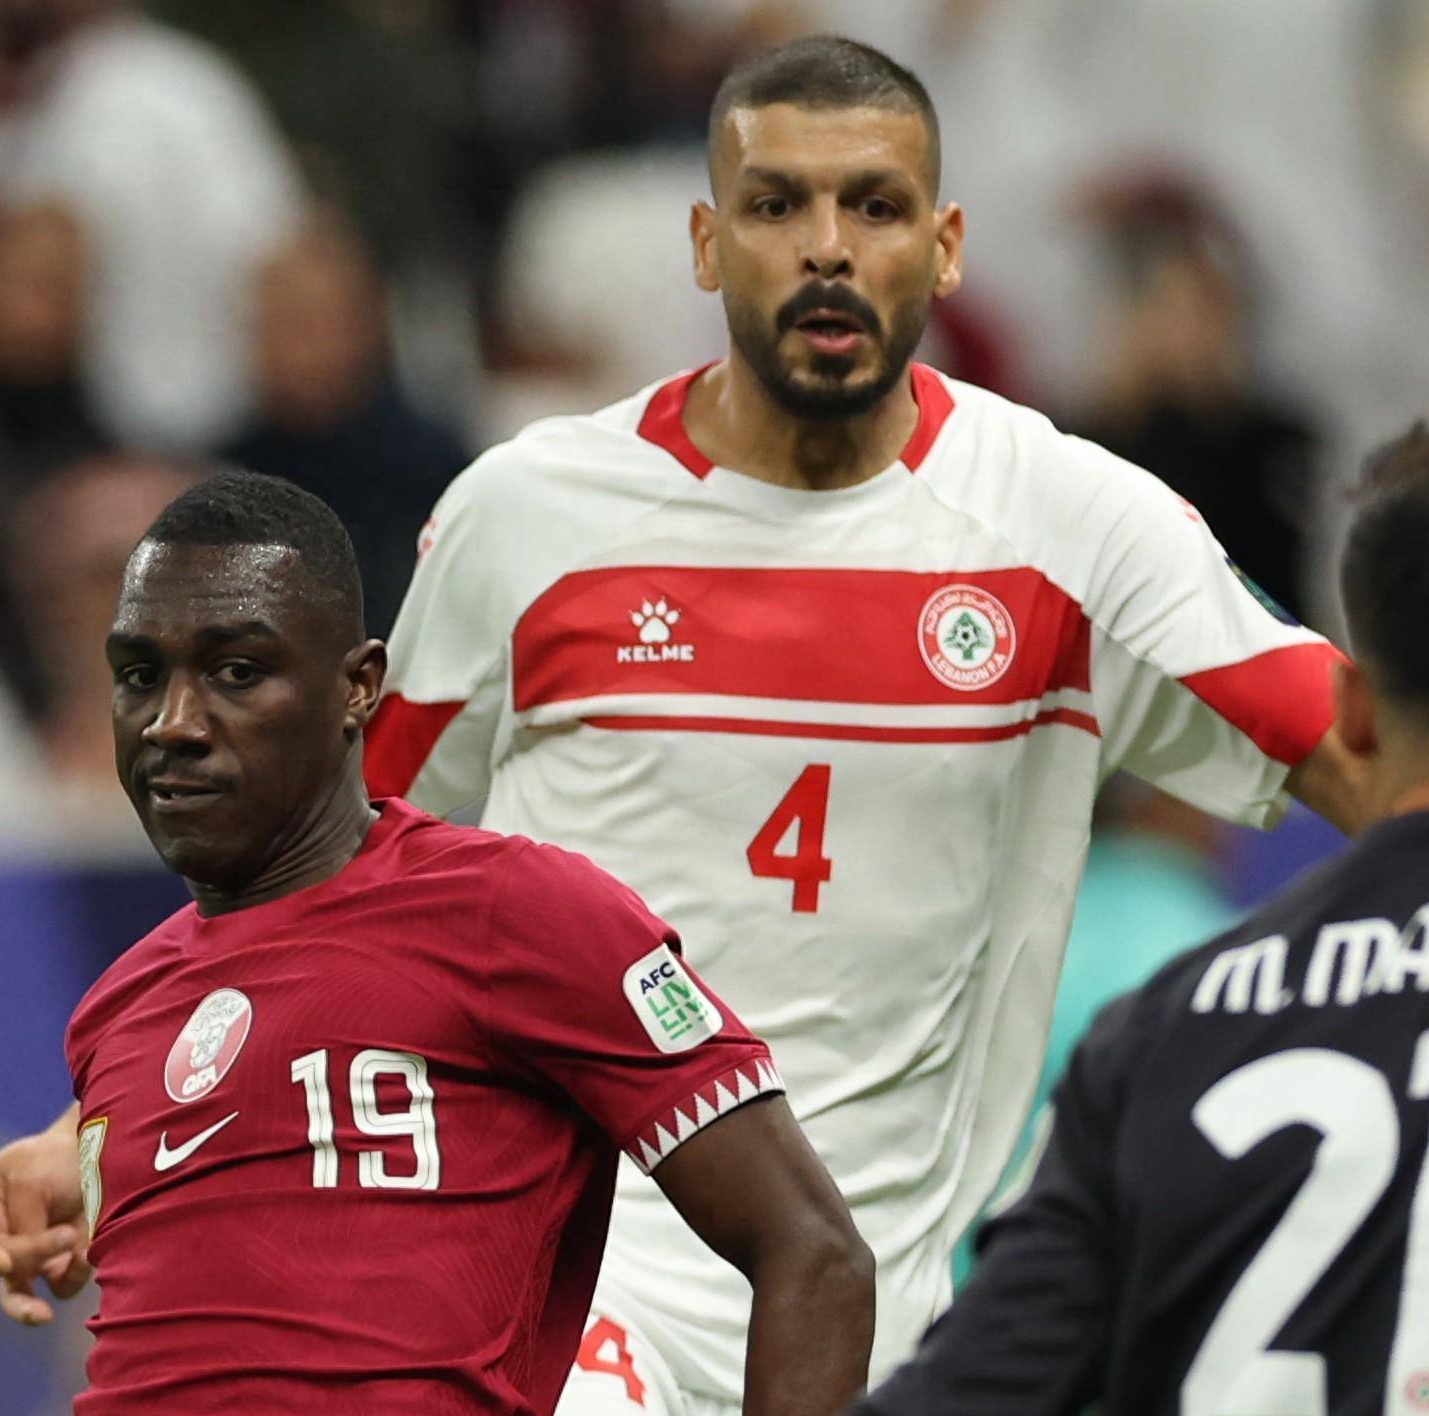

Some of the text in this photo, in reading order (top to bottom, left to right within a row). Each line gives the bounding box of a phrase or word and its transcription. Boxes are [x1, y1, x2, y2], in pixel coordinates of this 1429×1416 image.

[616, 644, 695, 664] KELME
[932, 653, 990, 684] LEBANON
[746, 763, 832, 913] 4
[639, 961, 676, 995] AFC
[291, 1048, 440, 1191] 19
[575, 1315, 646, 1408] 4
